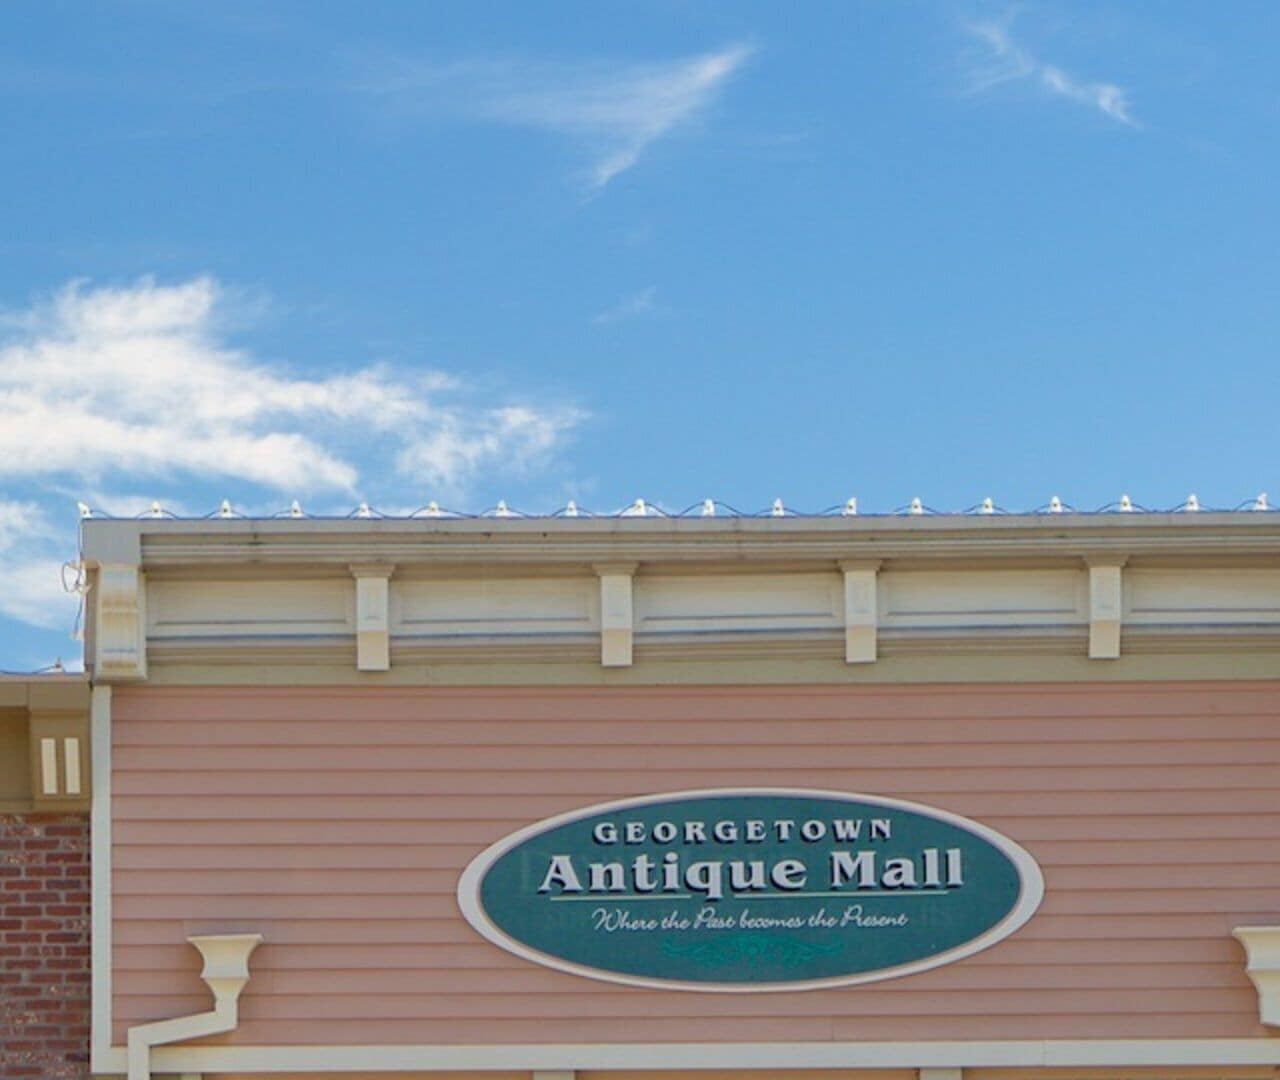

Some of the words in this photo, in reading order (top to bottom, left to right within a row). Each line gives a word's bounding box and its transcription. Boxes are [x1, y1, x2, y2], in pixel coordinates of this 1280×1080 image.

[592, 818, 894, 845] GEORGETOWN
[537, 850, 809, 899] Antique
[829, 848, 965, 889] Mall
[591, 906, 659, 932] Where
[660, 907, 690, 930] the
[693, 907, 736, 930] Past
[738, 906, 806, 930] becomes
[808, 905, 838, 929] the
[840, 903, 909, 928] Present
